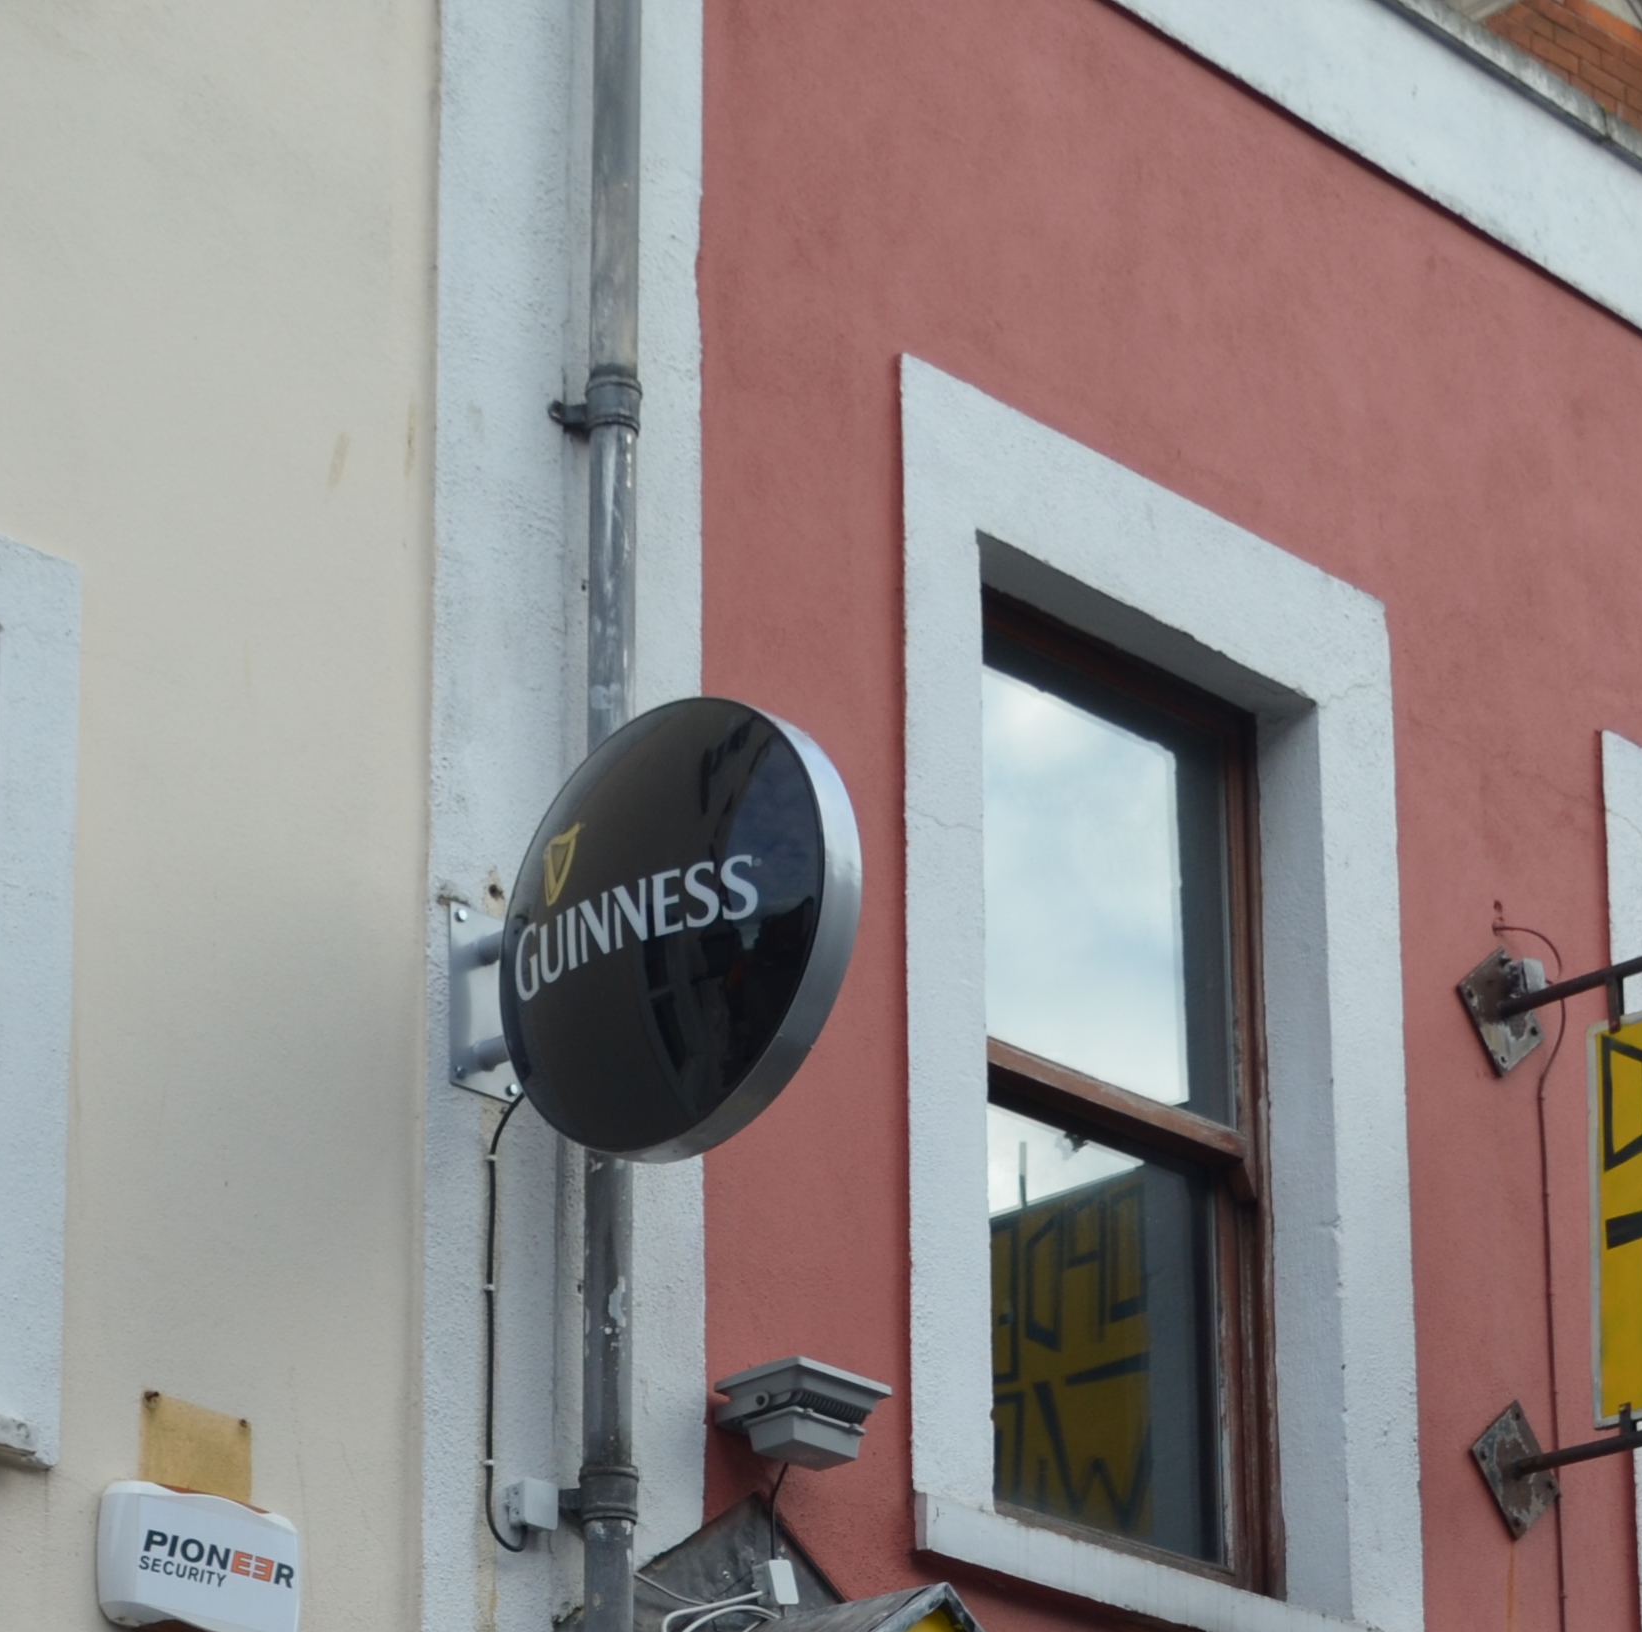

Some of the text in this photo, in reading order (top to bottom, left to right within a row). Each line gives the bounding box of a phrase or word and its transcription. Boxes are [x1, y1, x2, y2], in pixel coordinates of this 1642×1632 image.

[515, 855, 760, 1002] GUINNESS
[138, 1555, 226, 1588] SECURITY
[143, 1530, 294, 1588] PIONEER
